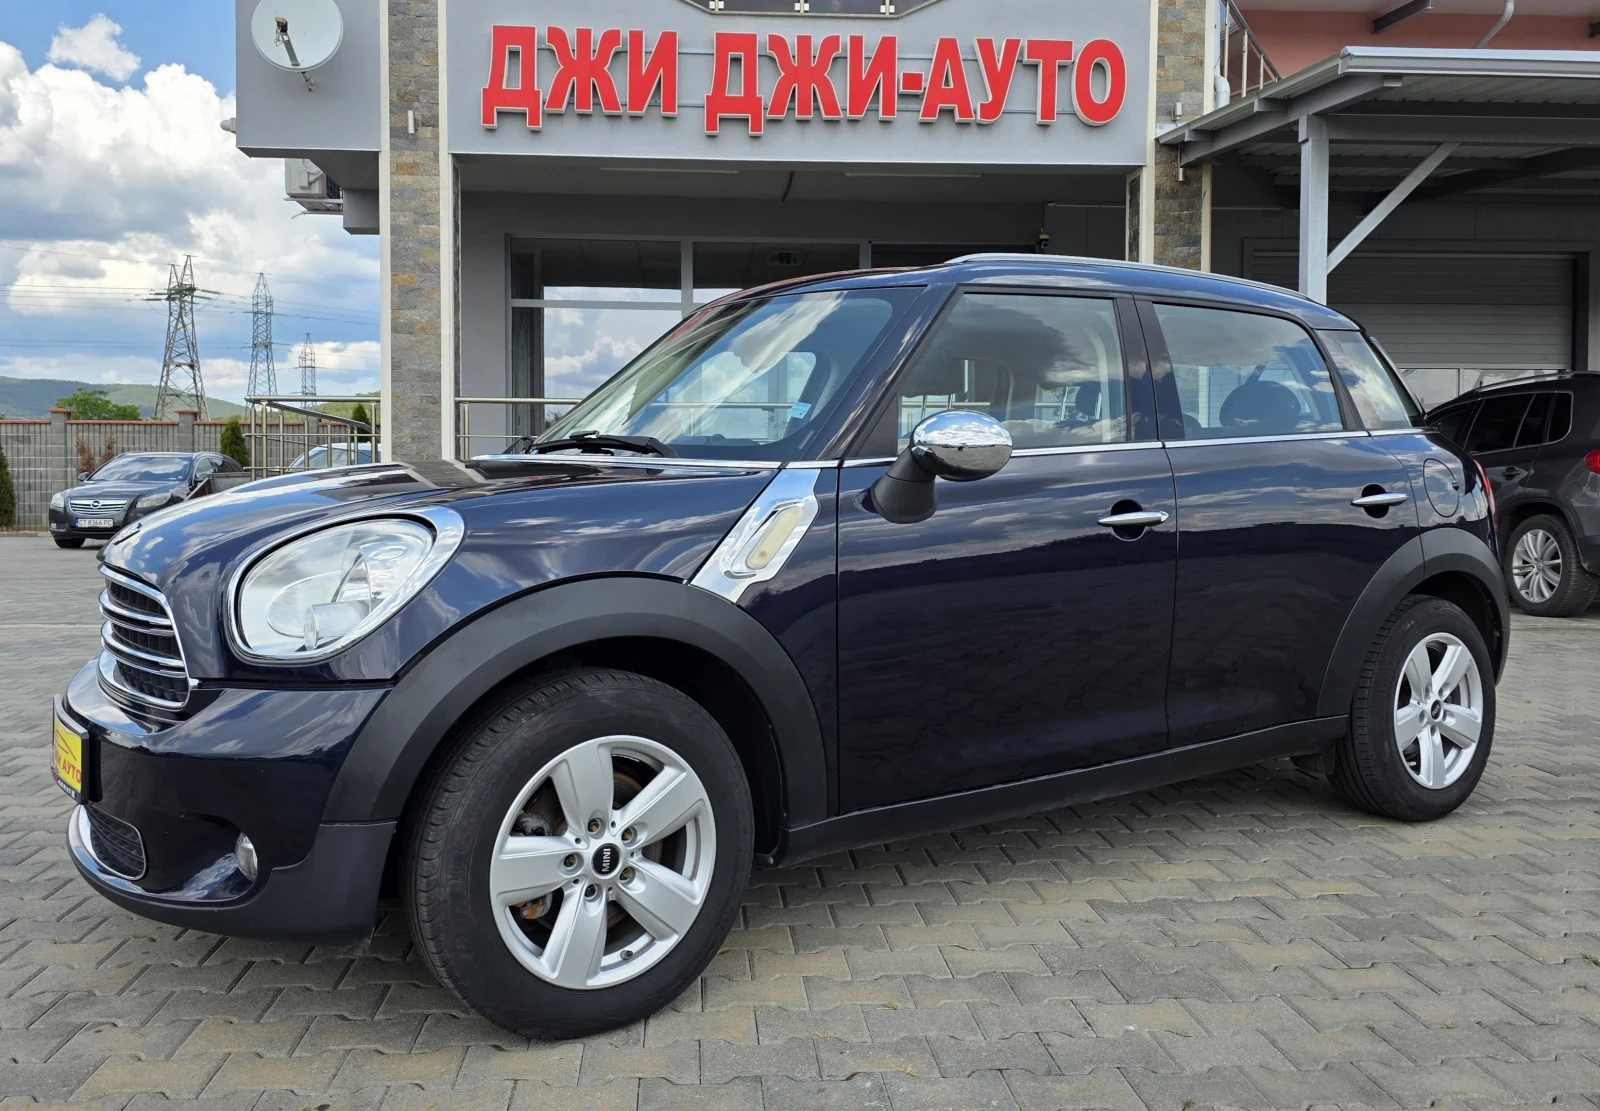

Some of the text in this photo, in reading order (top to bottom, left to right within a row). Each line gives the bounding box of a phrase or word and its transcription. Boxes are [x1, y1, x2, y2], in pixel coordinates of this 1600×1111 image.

[481, 24, 1128, 136] ДЖИ ДЖИ-АУТО
[601, 848, 611, 872] MINI
